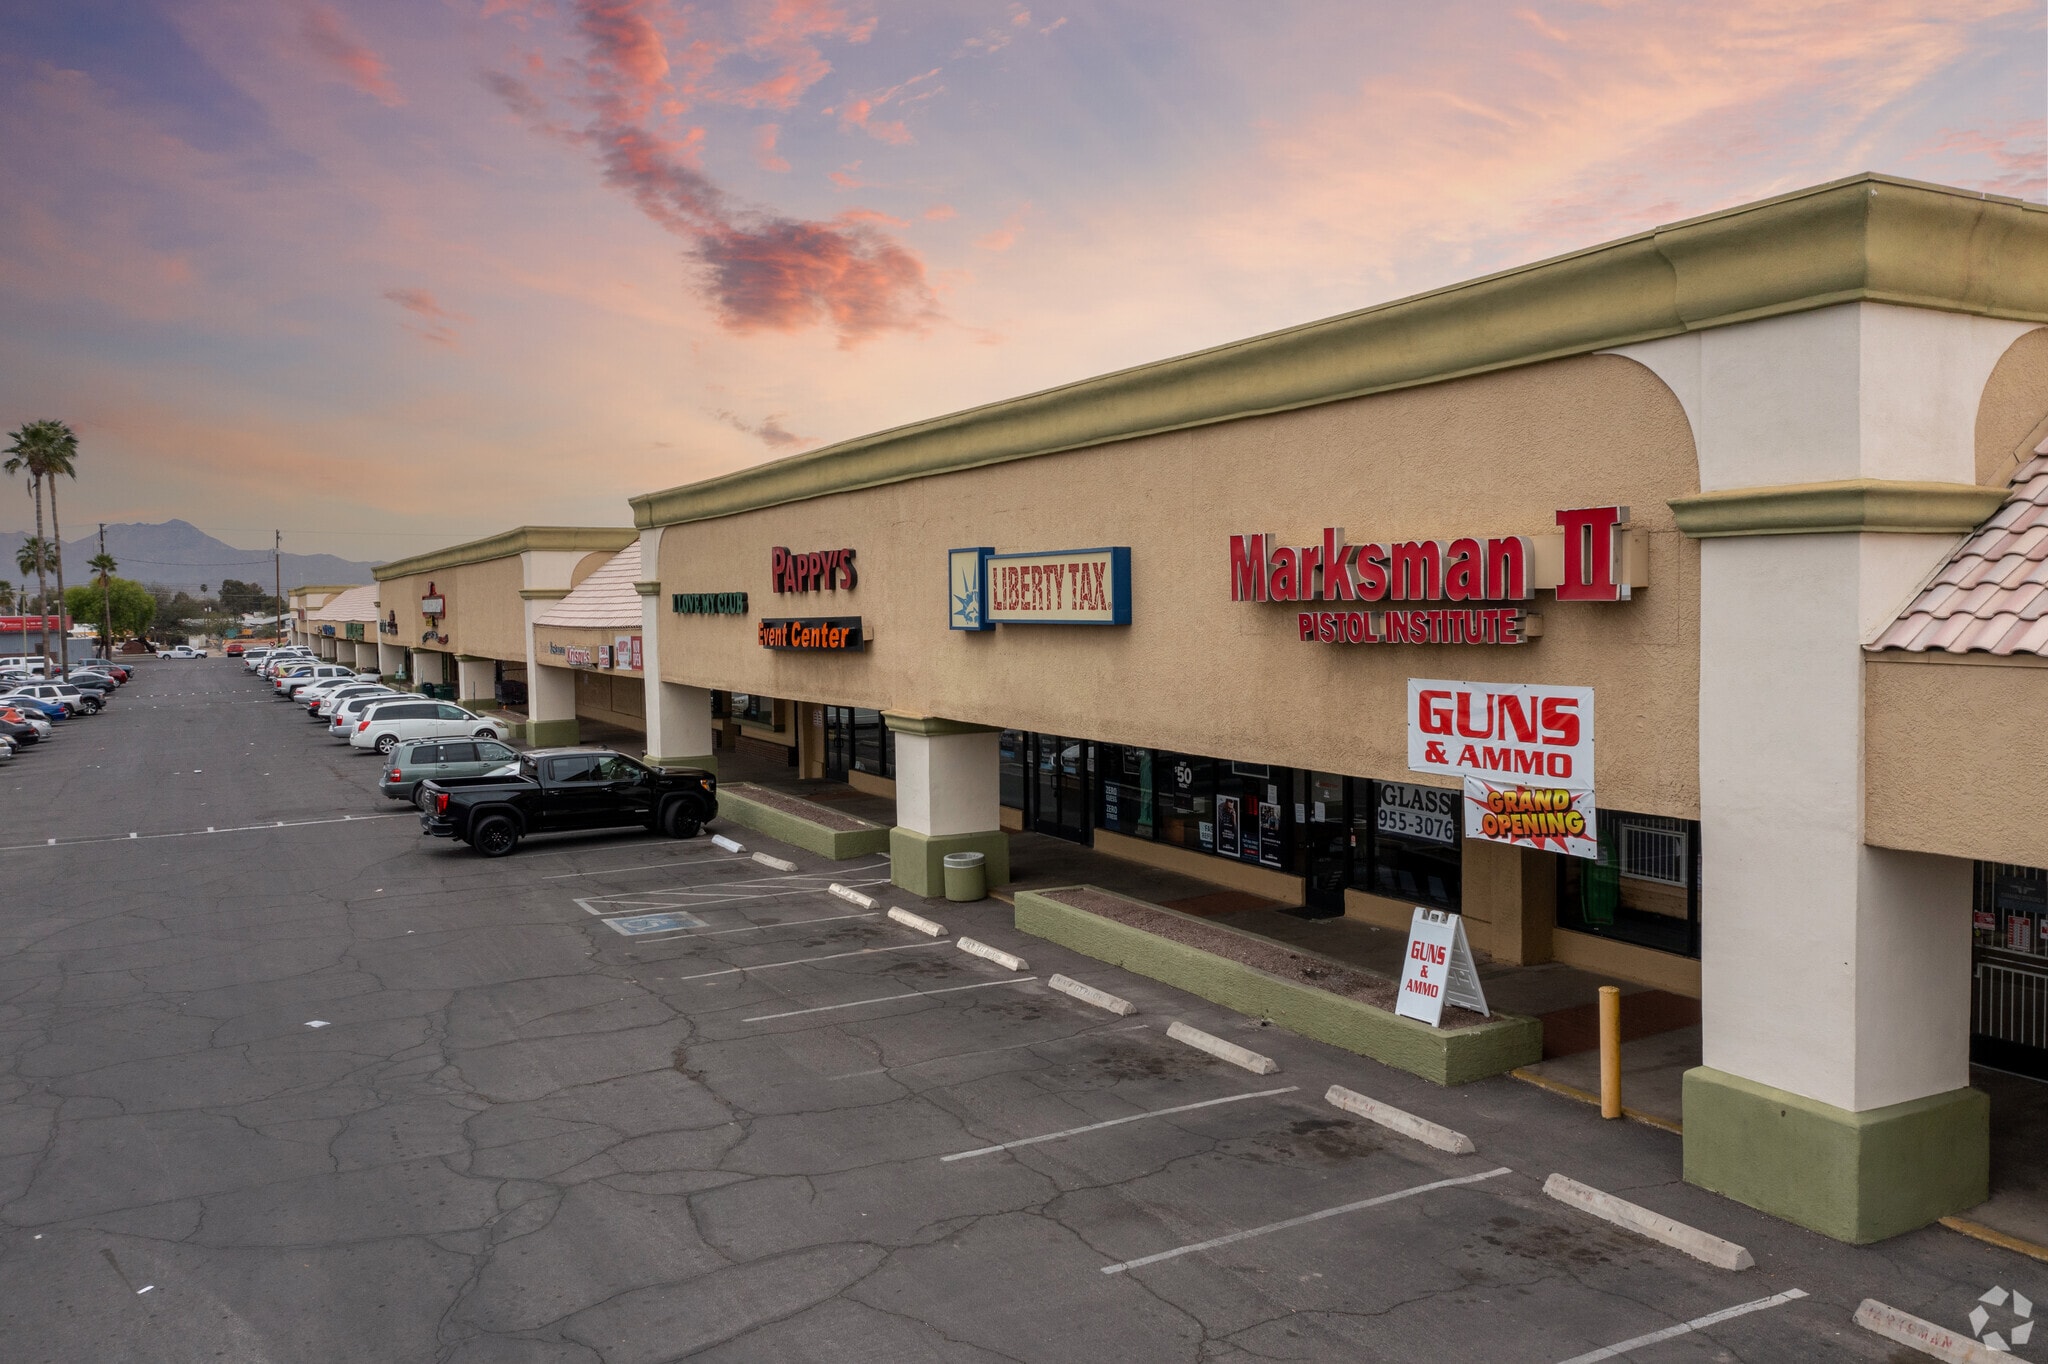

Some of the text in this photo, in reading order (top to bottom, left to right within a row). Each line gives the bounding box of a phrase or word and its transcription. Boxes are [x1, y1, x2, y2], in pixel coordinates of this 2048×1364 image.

[1230, 506, 1620, 602] Marksman II
[772, 546, 854, 593] PAPPY'S
[993, 564, 1065, 611] LIBERTY
[678, 594, 701, 614] LOVE
[701, 593, 715, 614] MY
[717, 592, 743, 614] CLUB
[758, 621, 849, 649] Event Center
[1298, 608, 1518, 644] PISTOL INSTITUTE
[1418, 689, 1580, 747] GUNS
[1425, 741, 1573, 779] & AMMO
[1174, 766, 1192, 785] $50
[1105, 785, 1118, 796] ZERO
[1381, 784, 1451, 816] GLASS
[1487, 788, 1573, 814] GRAND
[1106, 804, 1118, 814] ZERO
[1379, 809, 1453, 840] 955-3076
[1481, 809, 1585, 840] OPENING
[1410, 940, 1447, 966] GUNS
[1419, 965, 1429, 979] &
[1405, 978, 1439, 998] AMMO
